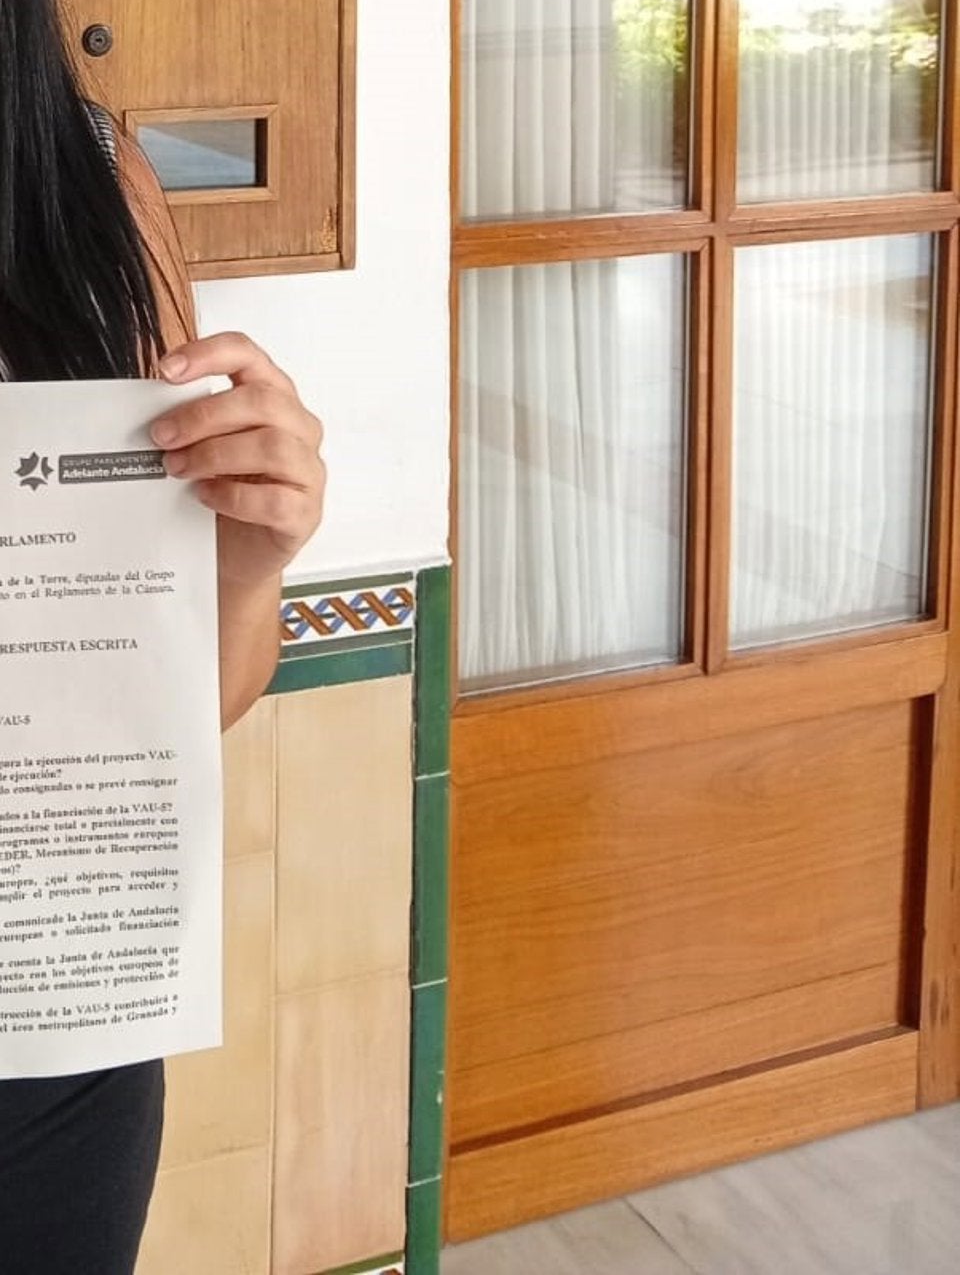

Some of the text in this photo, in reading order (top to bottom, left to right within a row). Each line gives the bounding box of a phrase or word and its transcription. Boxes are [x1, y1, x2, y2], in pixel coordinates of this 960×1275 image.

[63, 468, 110, 479] Adelante
[7, 576, 20, 587] de
[24, 575, 34, 585] la
[75, 572, 121, 585] diputadas
[124, 571, 140, 581] del
[144, 570, 175, 582] Grupo
[14, 591, 27, 600] en
[31, 589, 40, 599] el
[45, 585, 101, 600] Reglamento
[105, 585, 117, 595] de
[122, 585, 131, 595] la
[0, 640, 76, 655] RESPUESTA
[80, 638, 138, 651] ESCRITA
[24, 757, 33, 767] la
[36, 754, 82, 768] ejecución
[84, 753, 100, 764] del
[102, 752, 146, 766] proyecto
